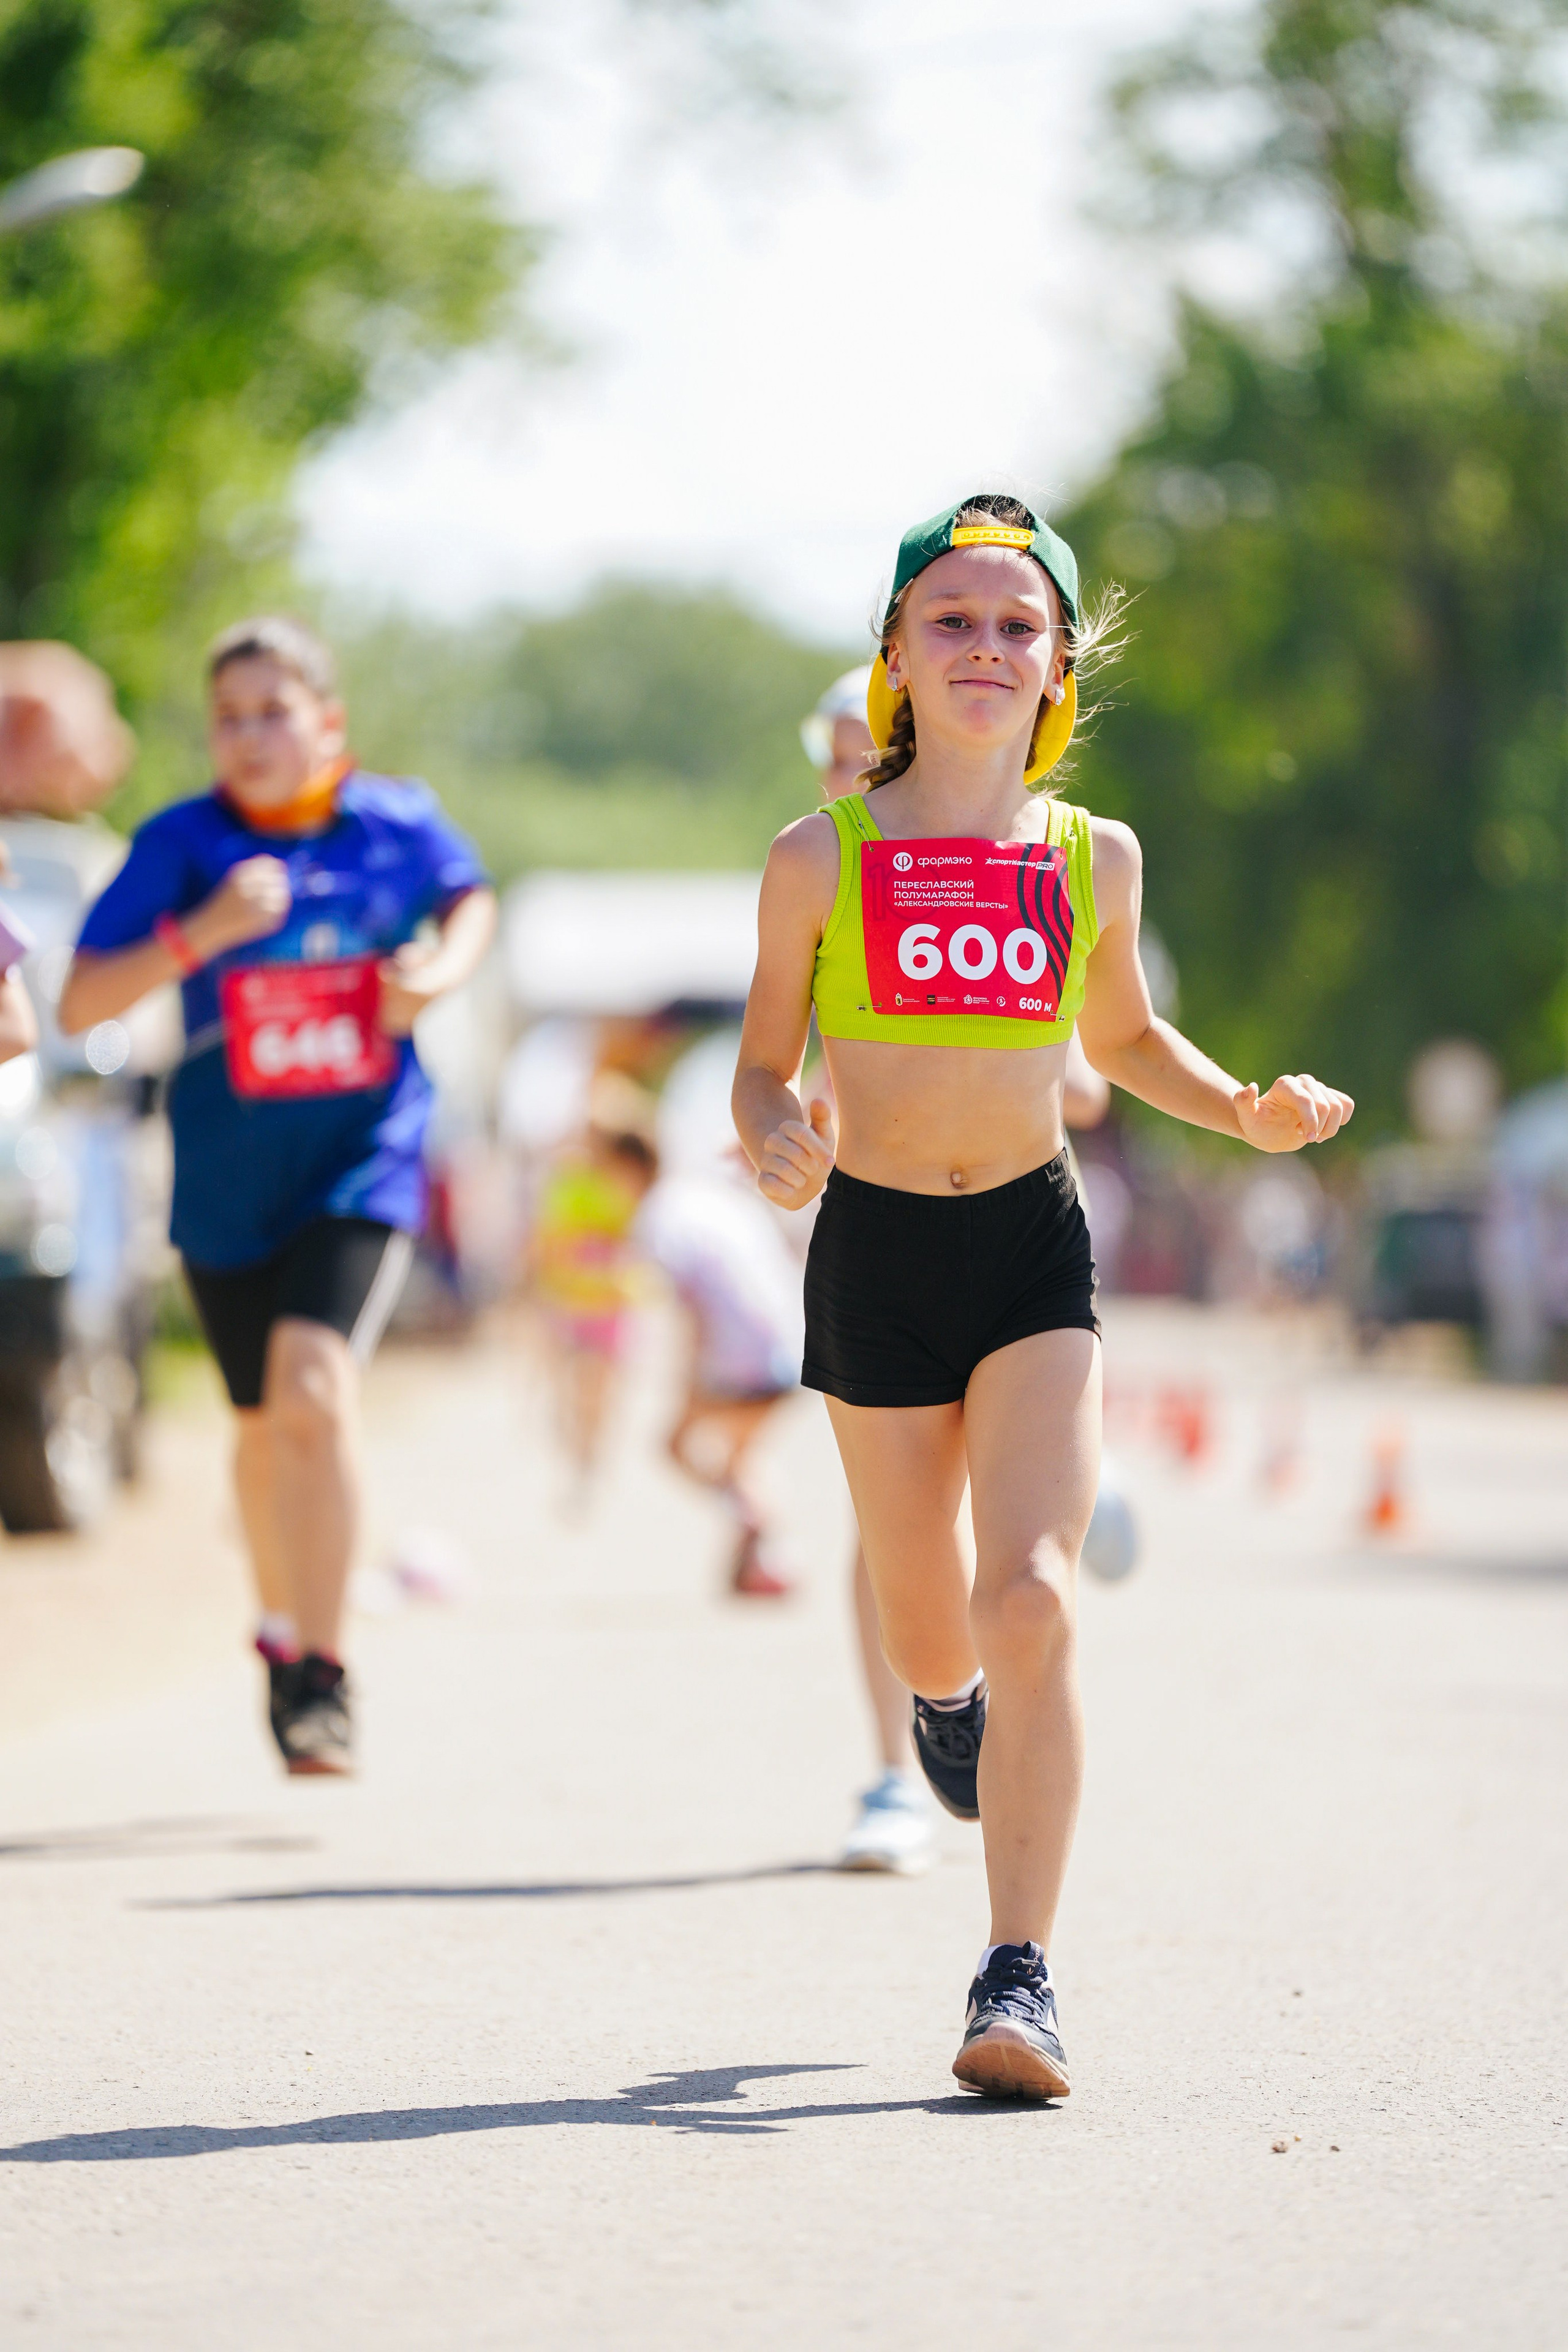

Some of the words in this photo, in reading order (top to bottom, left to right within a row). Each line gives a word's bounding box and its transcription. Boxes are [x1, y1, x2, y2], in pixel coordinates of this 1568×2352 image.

[918, 857, 973, 868] фармэко
[894, 880, 974, 889] ПЕРЕСЛАВСКИЙ
[894, 891, 974, 899] ПОЛУМАРАФОН
[897, 923, 1047, 985] 600
[1019, 997, 1042, 1011] 600
